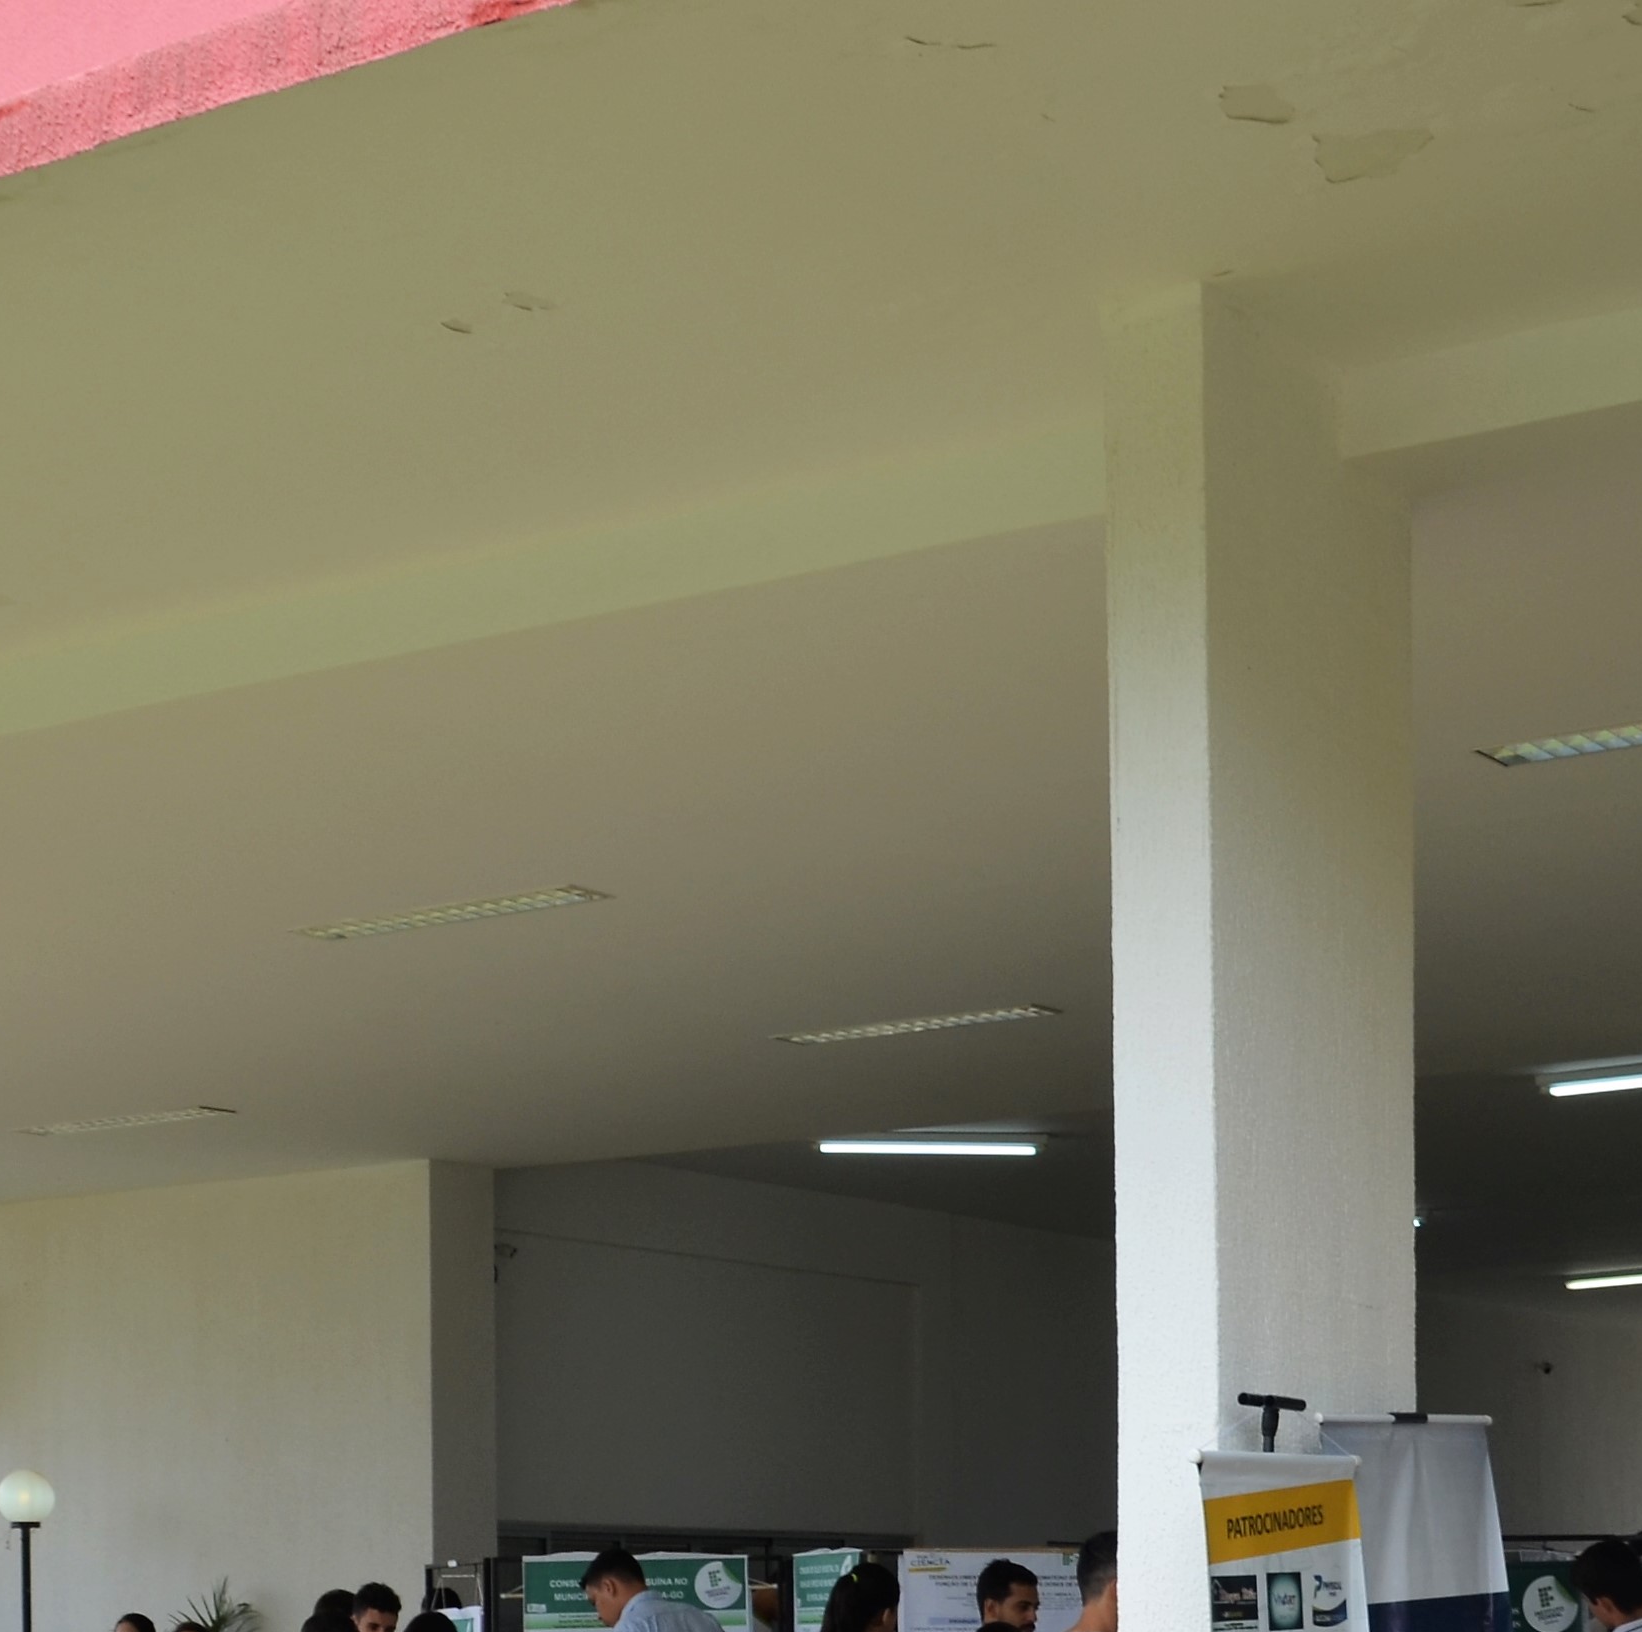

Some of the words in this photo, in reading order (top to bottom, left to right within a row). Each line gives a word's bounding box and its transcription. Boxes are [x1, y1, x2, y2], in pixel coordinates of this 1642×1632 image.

[1226, 1504, 1324, 1539] PATROCINADORES
[549, 1579, 581, 1589] CONSU
[661, 1590, 684, 1599] A-GO
